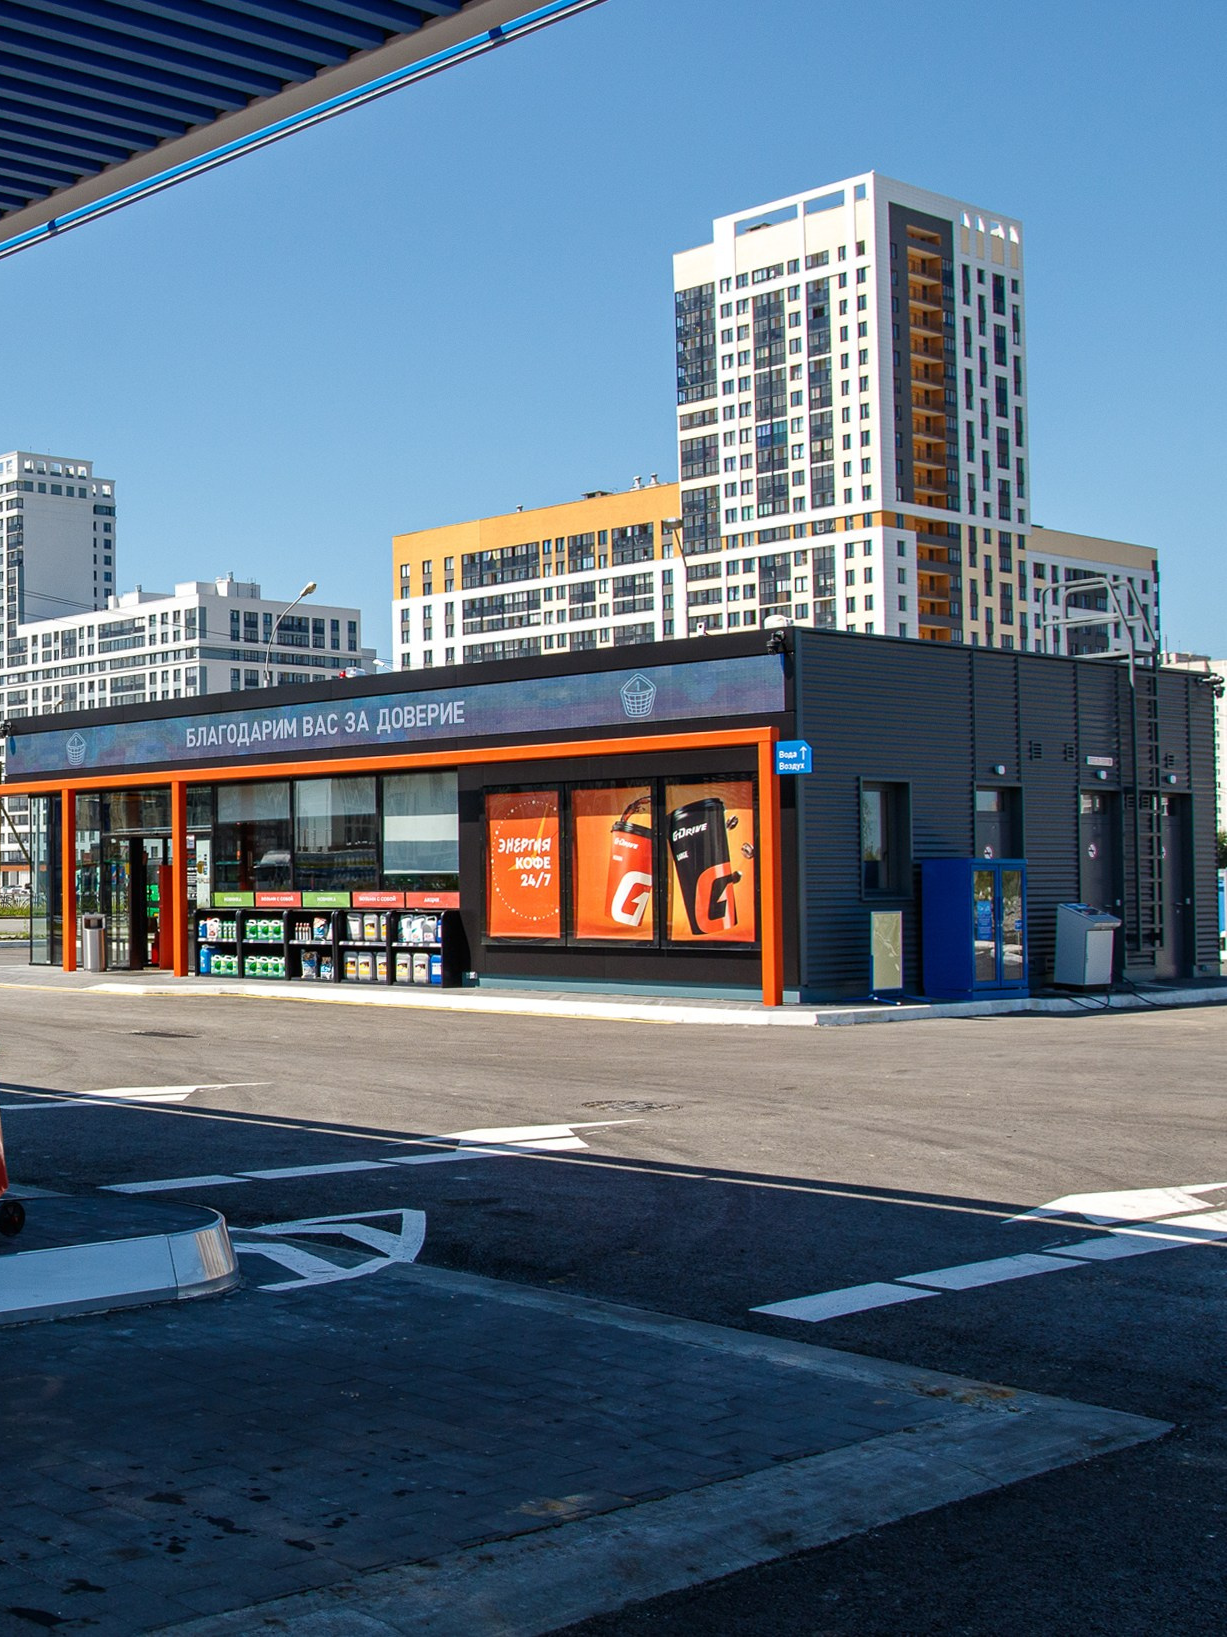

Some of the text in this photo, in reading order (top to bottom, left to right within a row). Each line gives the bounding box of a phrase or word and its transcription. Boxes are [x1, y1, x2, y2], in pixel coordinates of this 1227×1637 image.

[186, 701, 466, 748] БЛАГОДАРИМ ВАС ЗА ДОВЕРИЕ
[779, 750, 797, 759] Вода
[779, 762, 805, 771] Воздух
[498, 837, 551, 854] ЭНЕРГИЯ
[515, 856, 551, 870] КОФЕ
[520, 873, 551, 887] 24/7
